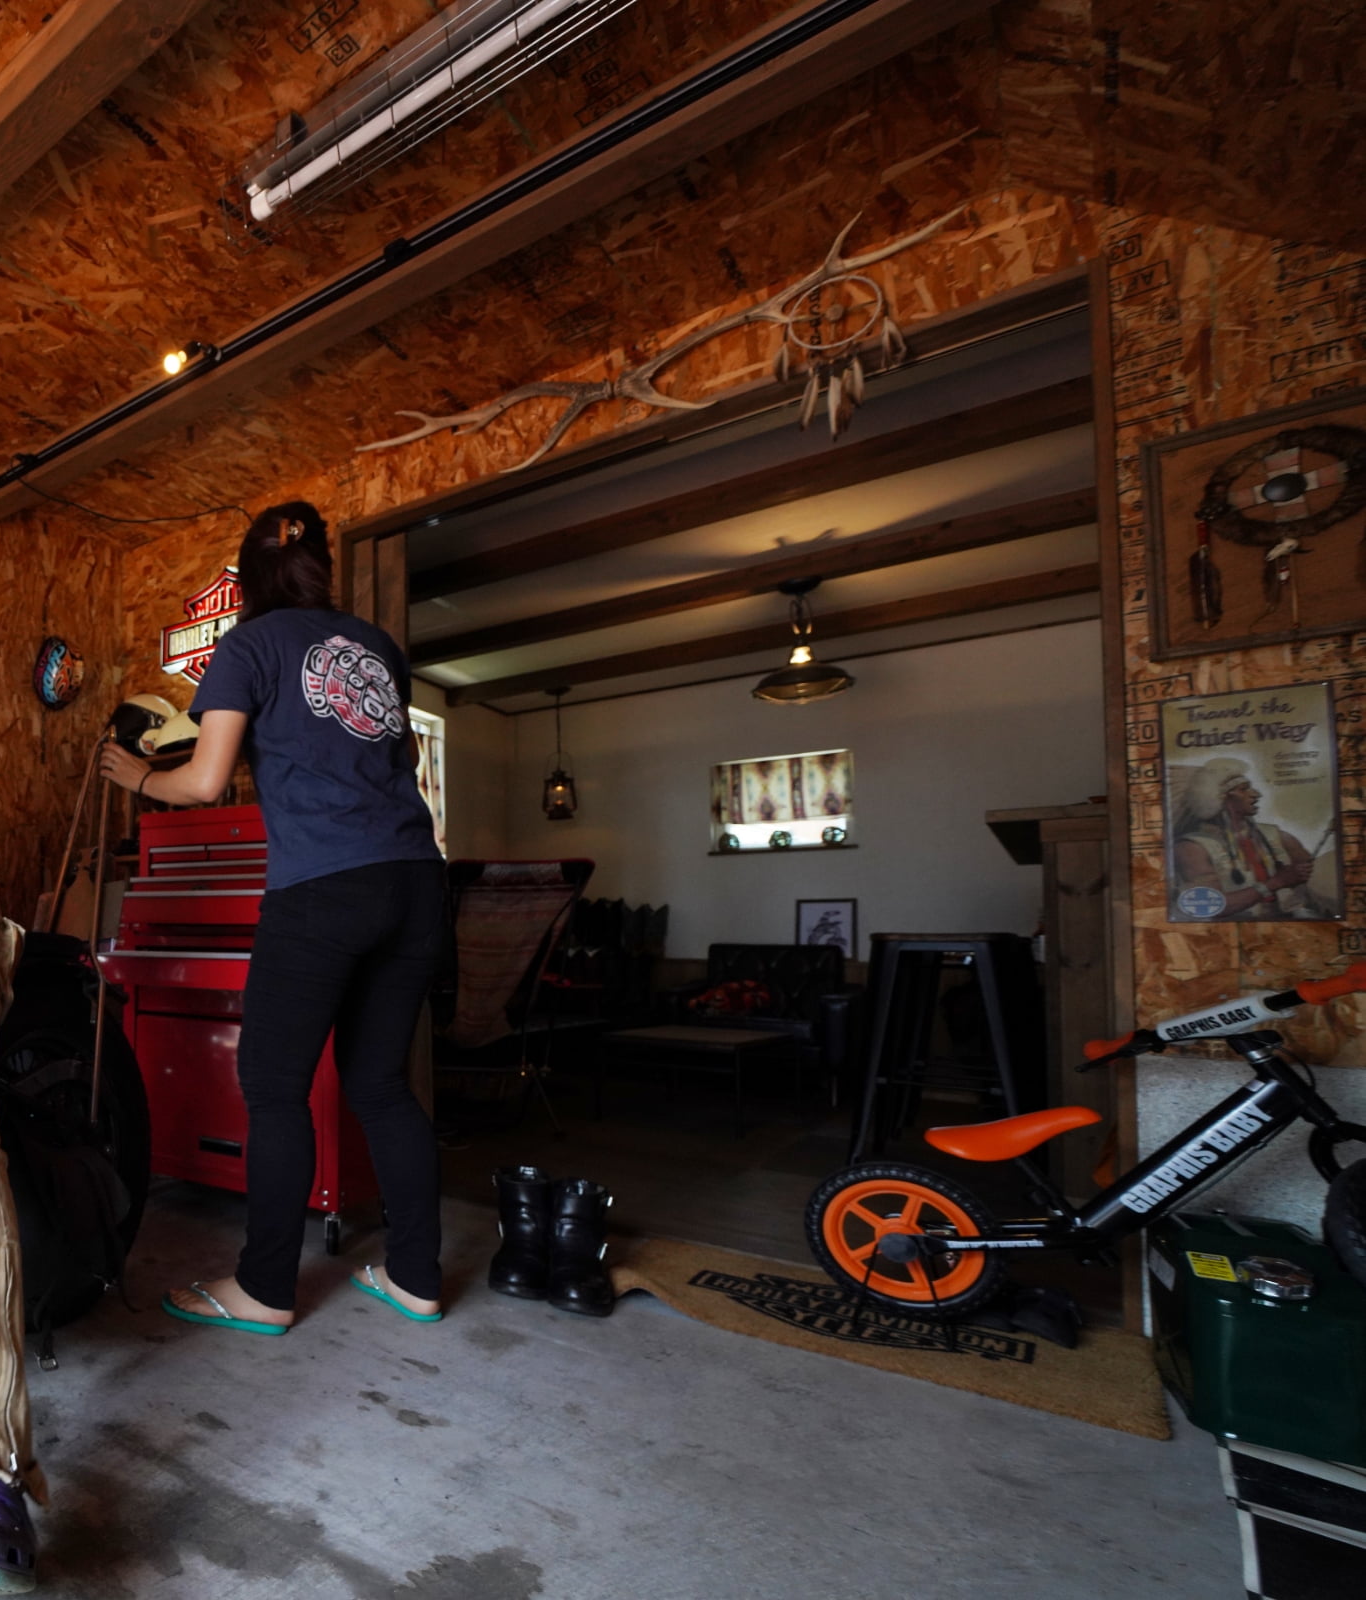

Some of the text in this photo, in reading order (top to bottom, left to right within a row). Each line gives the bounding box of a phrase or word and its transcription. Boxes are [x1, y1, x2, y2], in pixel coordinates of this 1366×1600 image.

[1178, 697, 1295, 722] Travel the
[1176, 722, 1316, 748] Chief Way
[1166, 1006, 1258, 1040] GRAPHIS BABY
[1120, 1102, 1275, 1214] GRAPHIS BABY
